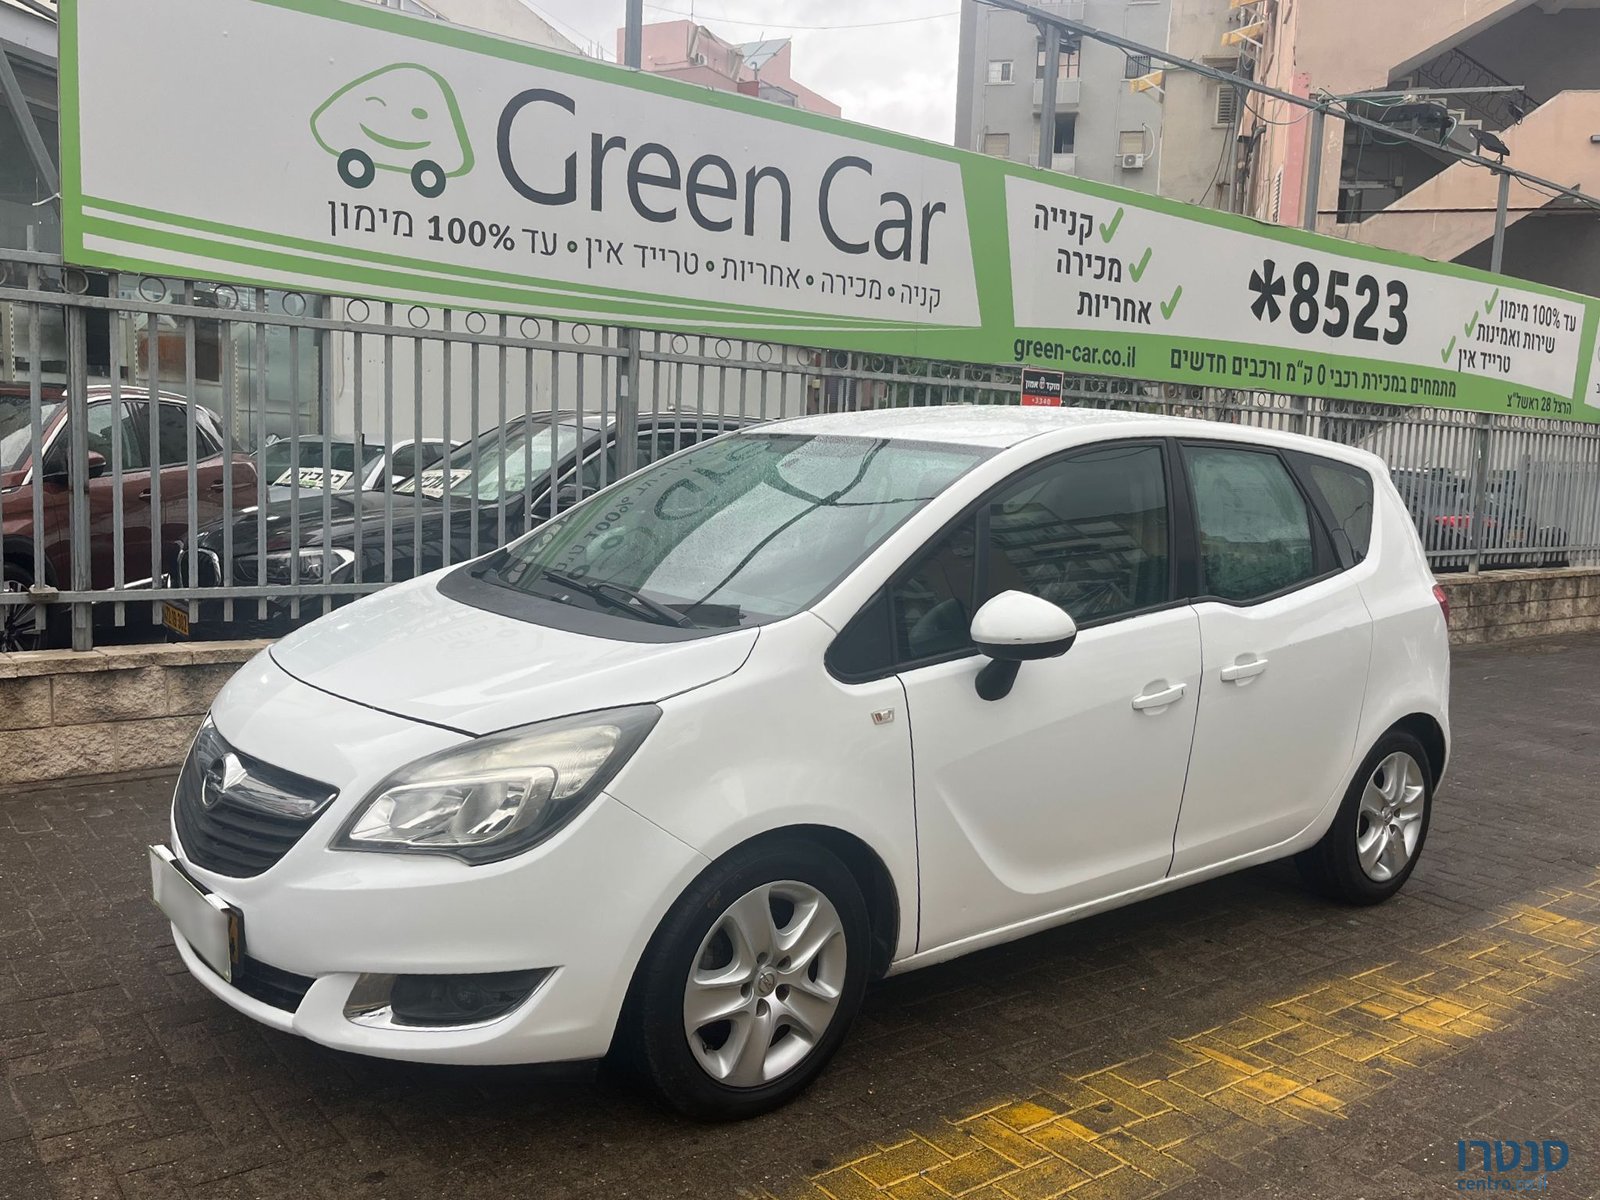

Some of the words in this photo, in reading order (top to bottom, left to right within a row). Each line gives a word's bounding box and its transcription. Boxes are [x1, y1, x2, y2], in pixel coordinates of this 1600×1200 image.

[496, 88, 791, 242] Green
[818, 155, 946, 265] Car
[327, 200, 414, 238] מימון
[1034, 203, 1094, 246] קנייה
[427, 214, 516, 251] 100%
[521, 228, 558, 256] עד
[585, 237, 624, 269] אין
[633, 242, 700, 275] טרייד
[1056, 248, 1122, 283] מכירה
[720, 256, 801, 290] אחריות
[821, 271, 882, 301] מכירה
[900, 283, 941, 313] קניה
[1077, 291, 1152, 325] אחריות
[1499, 299, 1529, 323] מימון
[1532, 303, 1561, 330] 100%
[1563, 313, 1577, 332] עד
[1476, 323, 1521, 348] ואמינות
[1522, 331, 1556, 354] שירות
[1013, 338, 1136, 368] green-car.co.il
[1170, 348, 1226, 374] חדשים
[1457, 348, 1477, 373] אין
[1480, 350, 1511, 374] טרייד
[1231, 355, 1281, 380] ורכבים
[1317, 363, 1326, 386] 0
[1329, 369, 1358, 389] רכבי
[1361, 371, 1407, 393] במכירת
[1410, 376, 1457, 399] מתמחים
[1540, 396, 1551, 412] 28
[1553, 395, 1572, 415] הרצל
